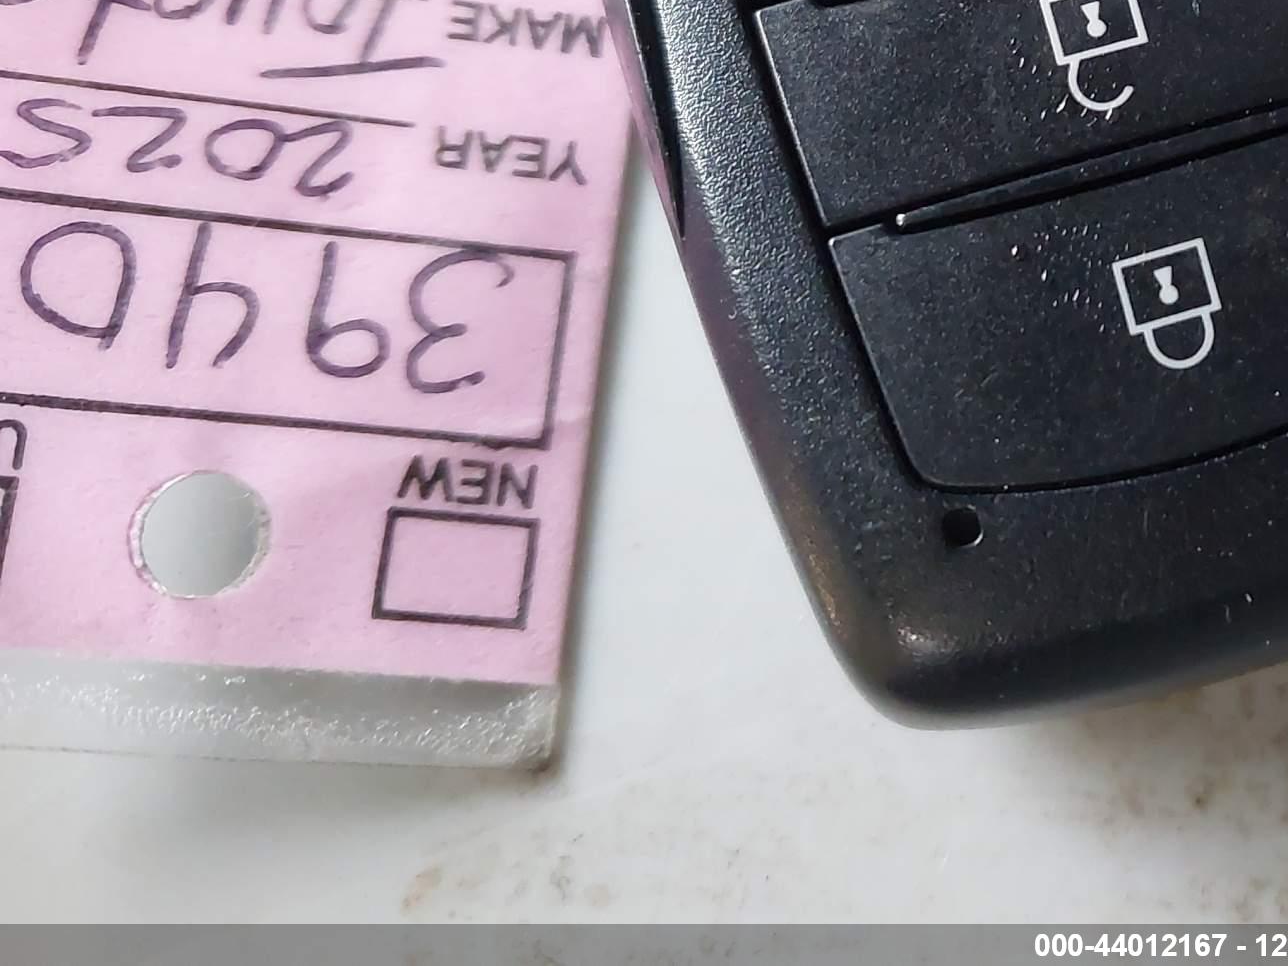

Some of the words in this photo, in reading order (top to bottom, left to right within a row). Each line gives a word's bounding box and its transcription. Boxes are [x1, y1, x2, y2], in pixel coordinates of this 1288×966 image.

[448, 0, 605, 58] MAKE
[0, 98, 355, 198] 2025
[434, 126, 586, 185] YEAR
[398, 455, 538, 509] NEW
